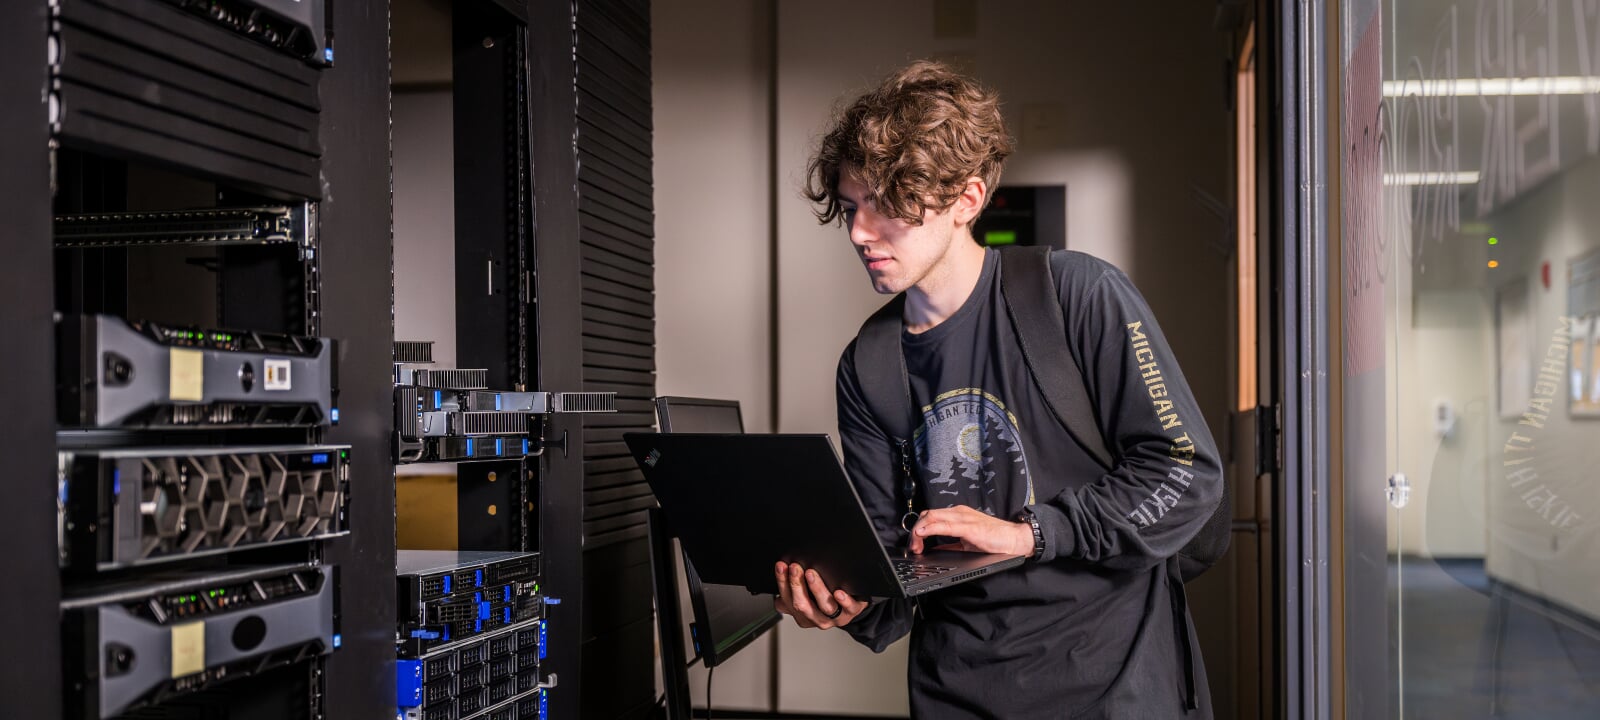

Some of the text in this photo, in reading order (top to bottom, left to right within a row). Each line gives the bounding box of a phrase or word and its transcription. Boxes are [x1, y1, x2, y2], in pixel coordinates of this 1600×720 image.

[928, 404, 983, 428] HIGAN TEC
[1127, 321, 1195, 467] MICHIGAN TE
[1126, 466, 1194, 529] HSKIE
